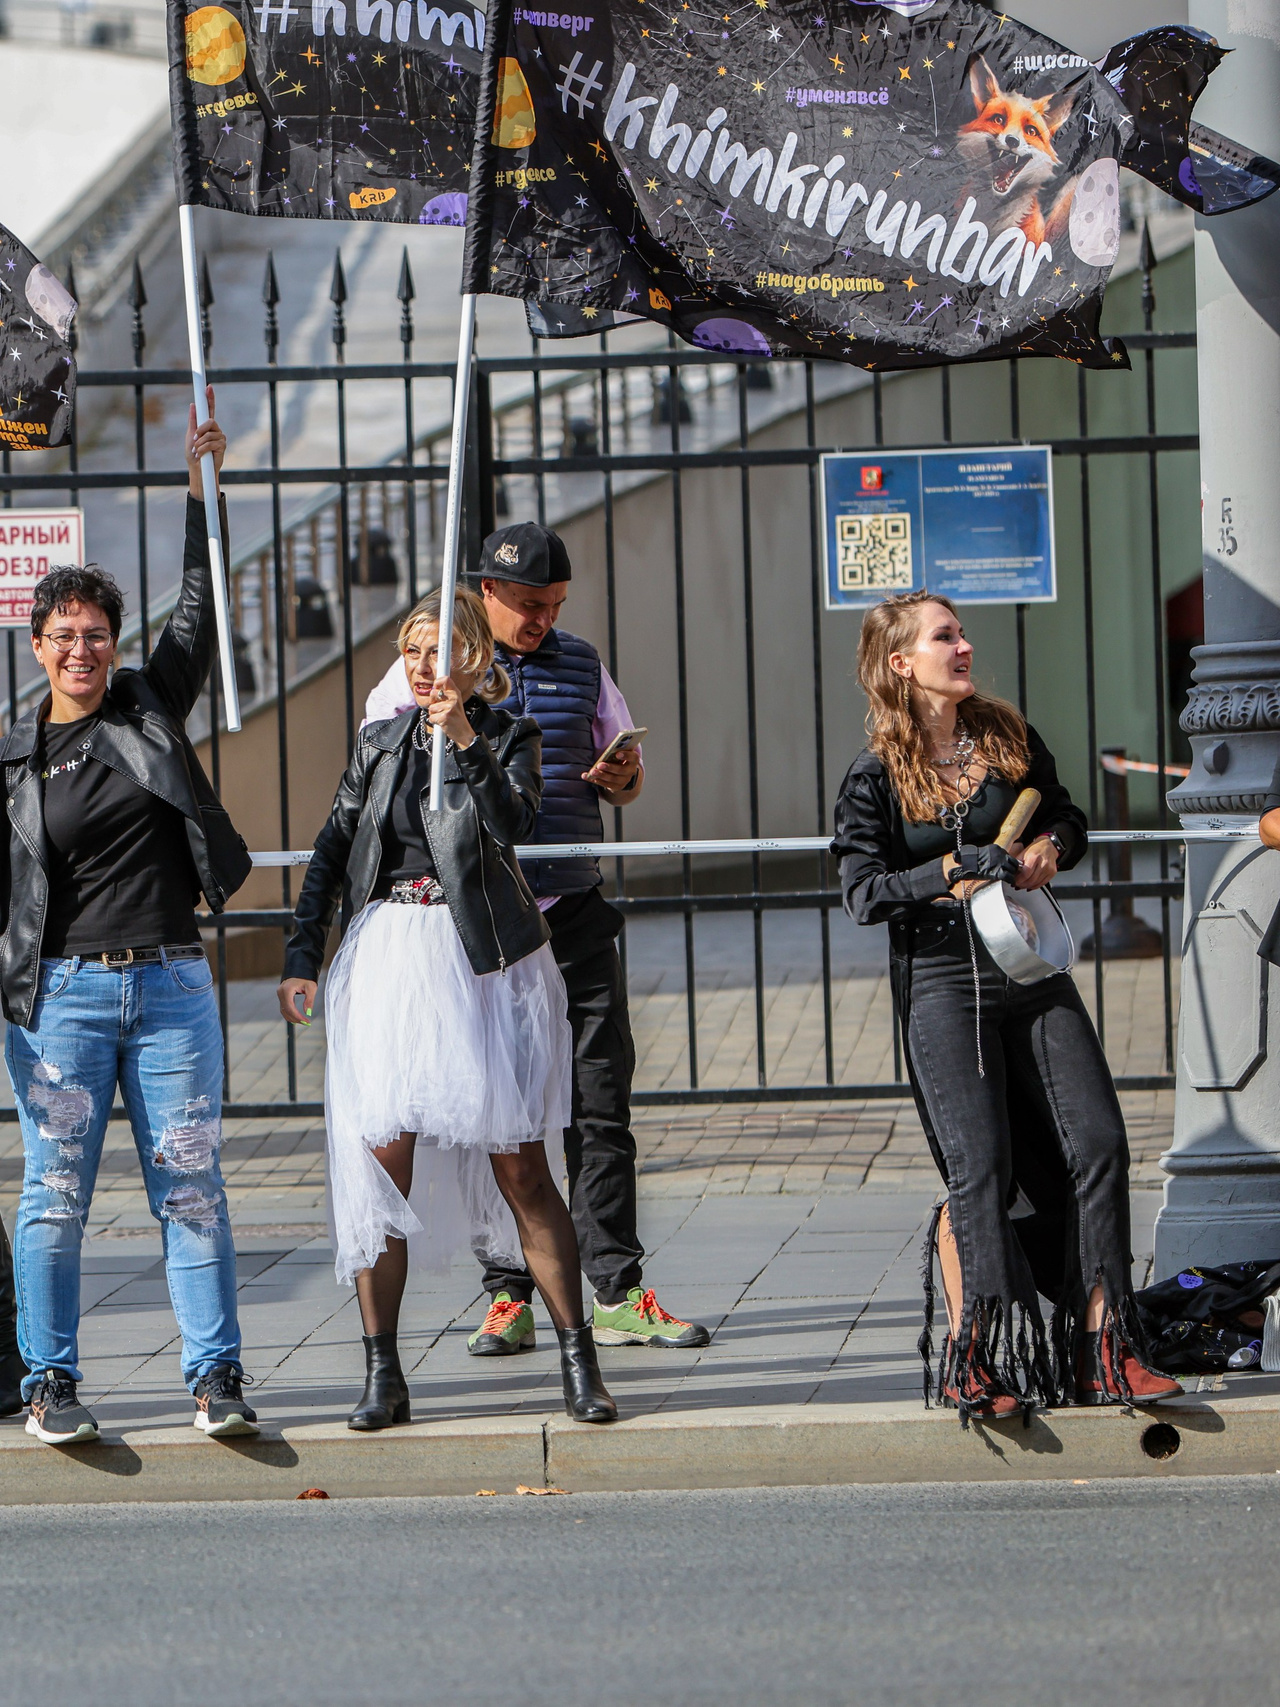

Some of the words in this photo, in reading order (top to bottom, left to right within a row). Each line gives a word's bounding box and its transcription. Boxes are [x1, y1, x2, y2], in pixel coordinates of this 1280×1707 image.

[1013, 53, 1093, 75] #щаст
[785, 86, 889, 107] #уменявсё
[555, 51, 1053, 298] #khimkirunbar
[755, 270, 885, 298] #надобрать
